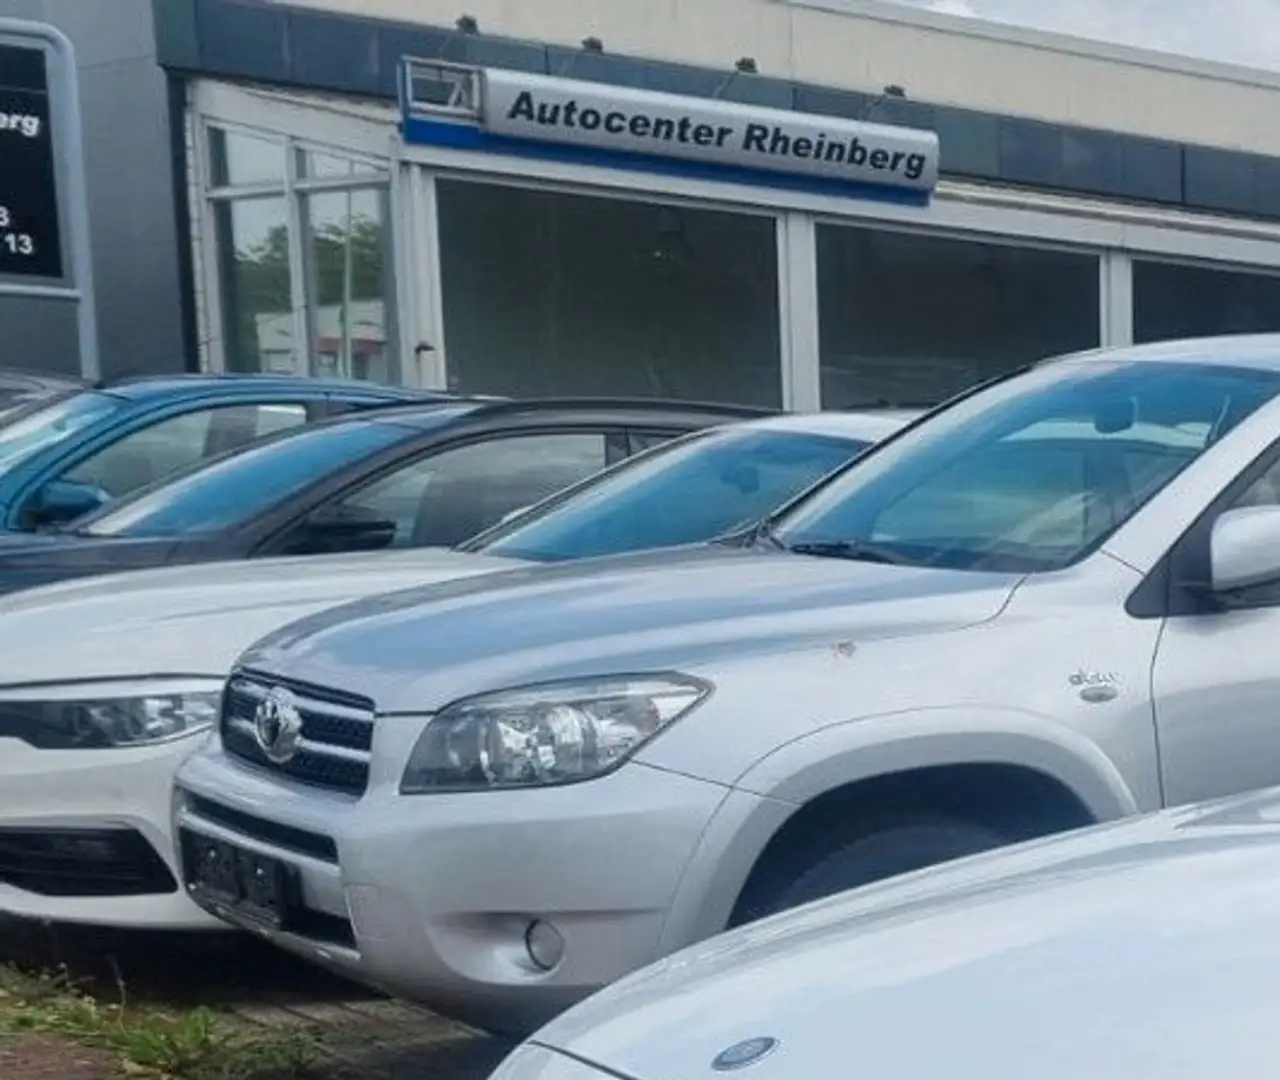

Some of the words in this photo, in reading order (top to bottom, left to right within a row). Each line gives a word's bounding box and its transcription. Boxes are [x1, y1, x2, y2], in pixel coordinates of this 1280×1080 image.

[508, 91, 733, 149] Autocenter
[741, 122, 927, 180] Rheinberg
[4, 232, 34, 255] 13
